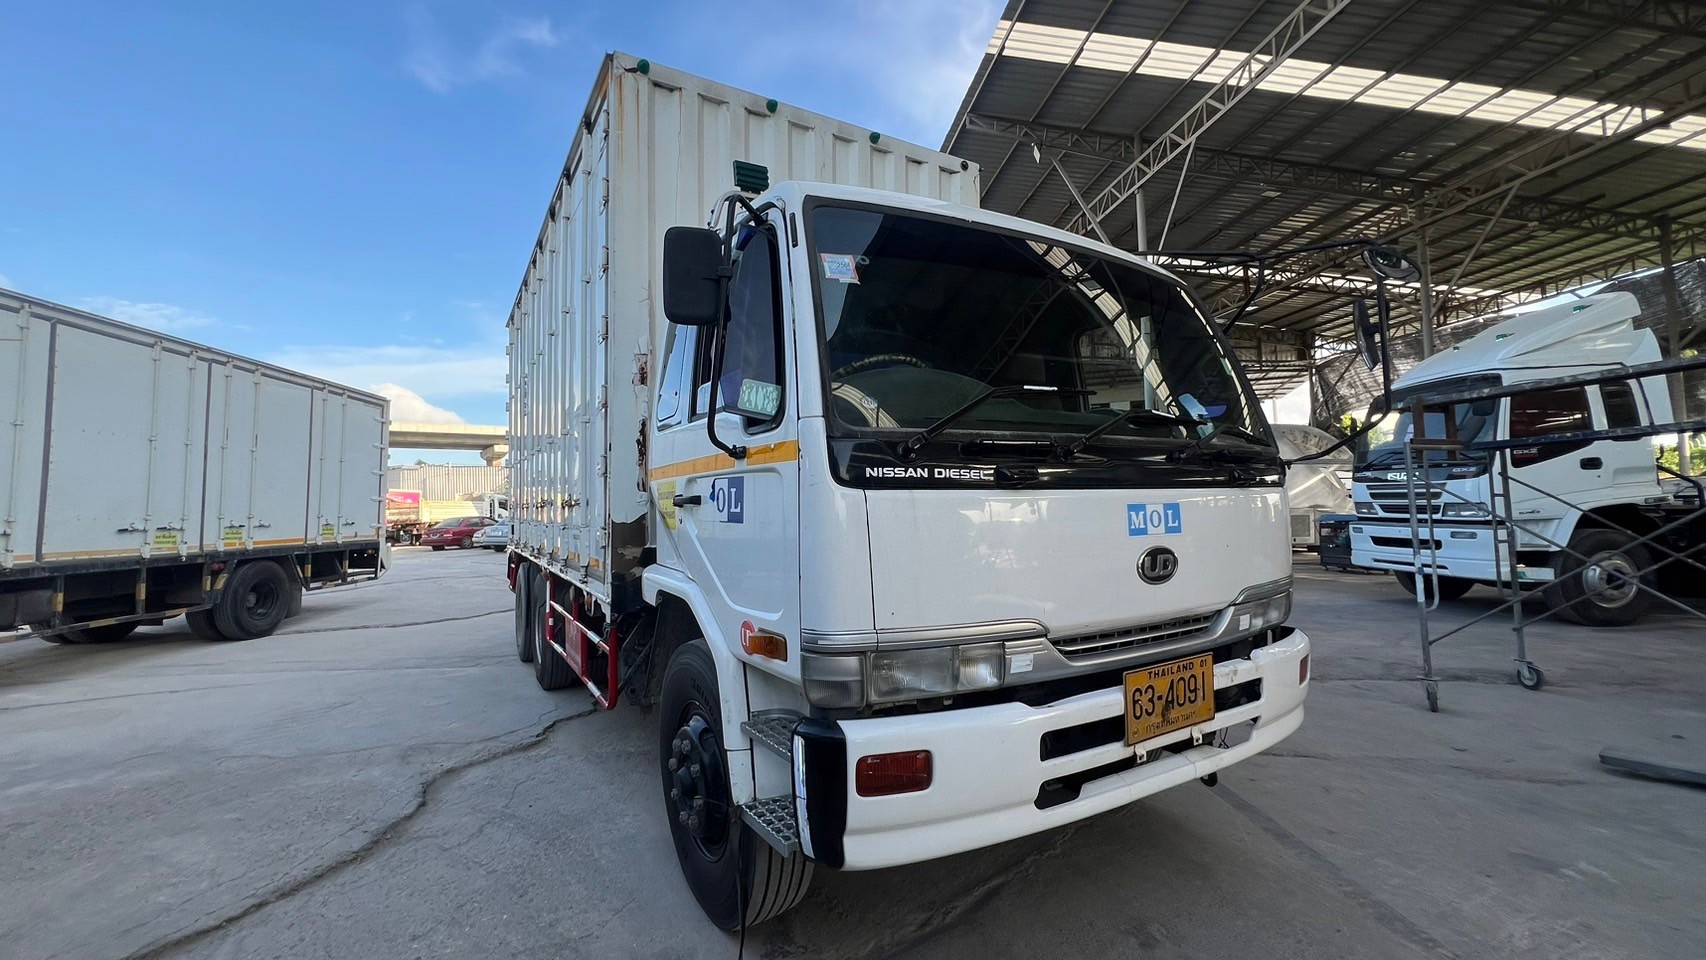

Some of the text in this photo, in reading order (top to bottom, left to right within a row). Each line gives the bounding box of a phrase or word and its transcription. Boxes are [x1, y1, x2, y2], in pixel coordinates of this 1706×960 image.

[866, 467, 994, 480] NISSAN DIESEL
[1129, 509, 1179, 529] MOL
[1144, 553, 1175, 578] UD
[1147, 658, 1207, 680] THAILAND 01
[1131, 671, 1206, 720] 63-4091
